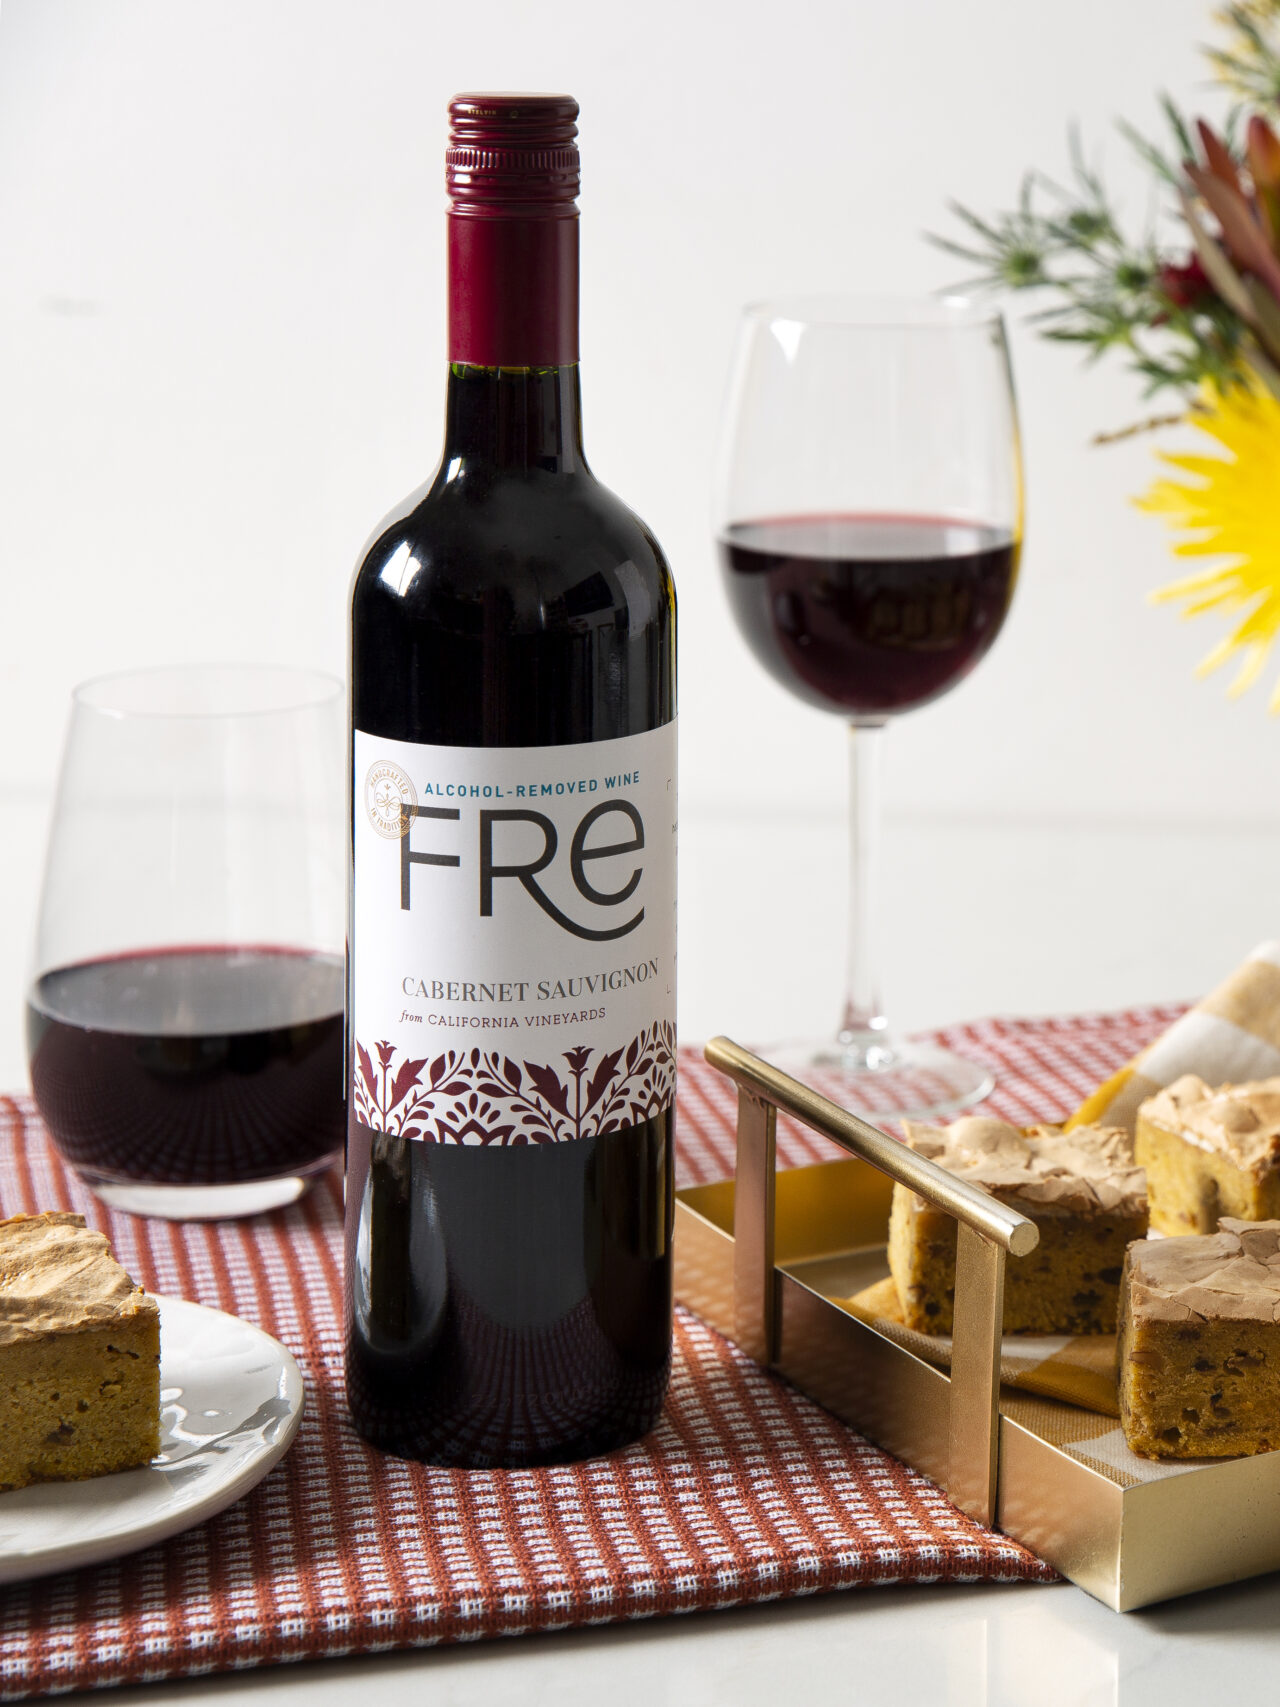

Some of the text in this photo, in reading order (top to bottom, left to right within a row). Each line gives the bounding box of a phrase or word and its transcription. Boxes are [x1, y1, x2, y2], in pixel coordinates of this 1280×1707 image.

[370, 768, 409, 795] HANDCRAFTED
[424, 770, 641, 798] ALCOHOL-REMOVED WINE
[401, 957, 659, 1002] CABERNET SAUVIGNON
[398, 1007, 607, 1028] from CALIFORNIA VINEYARDS
